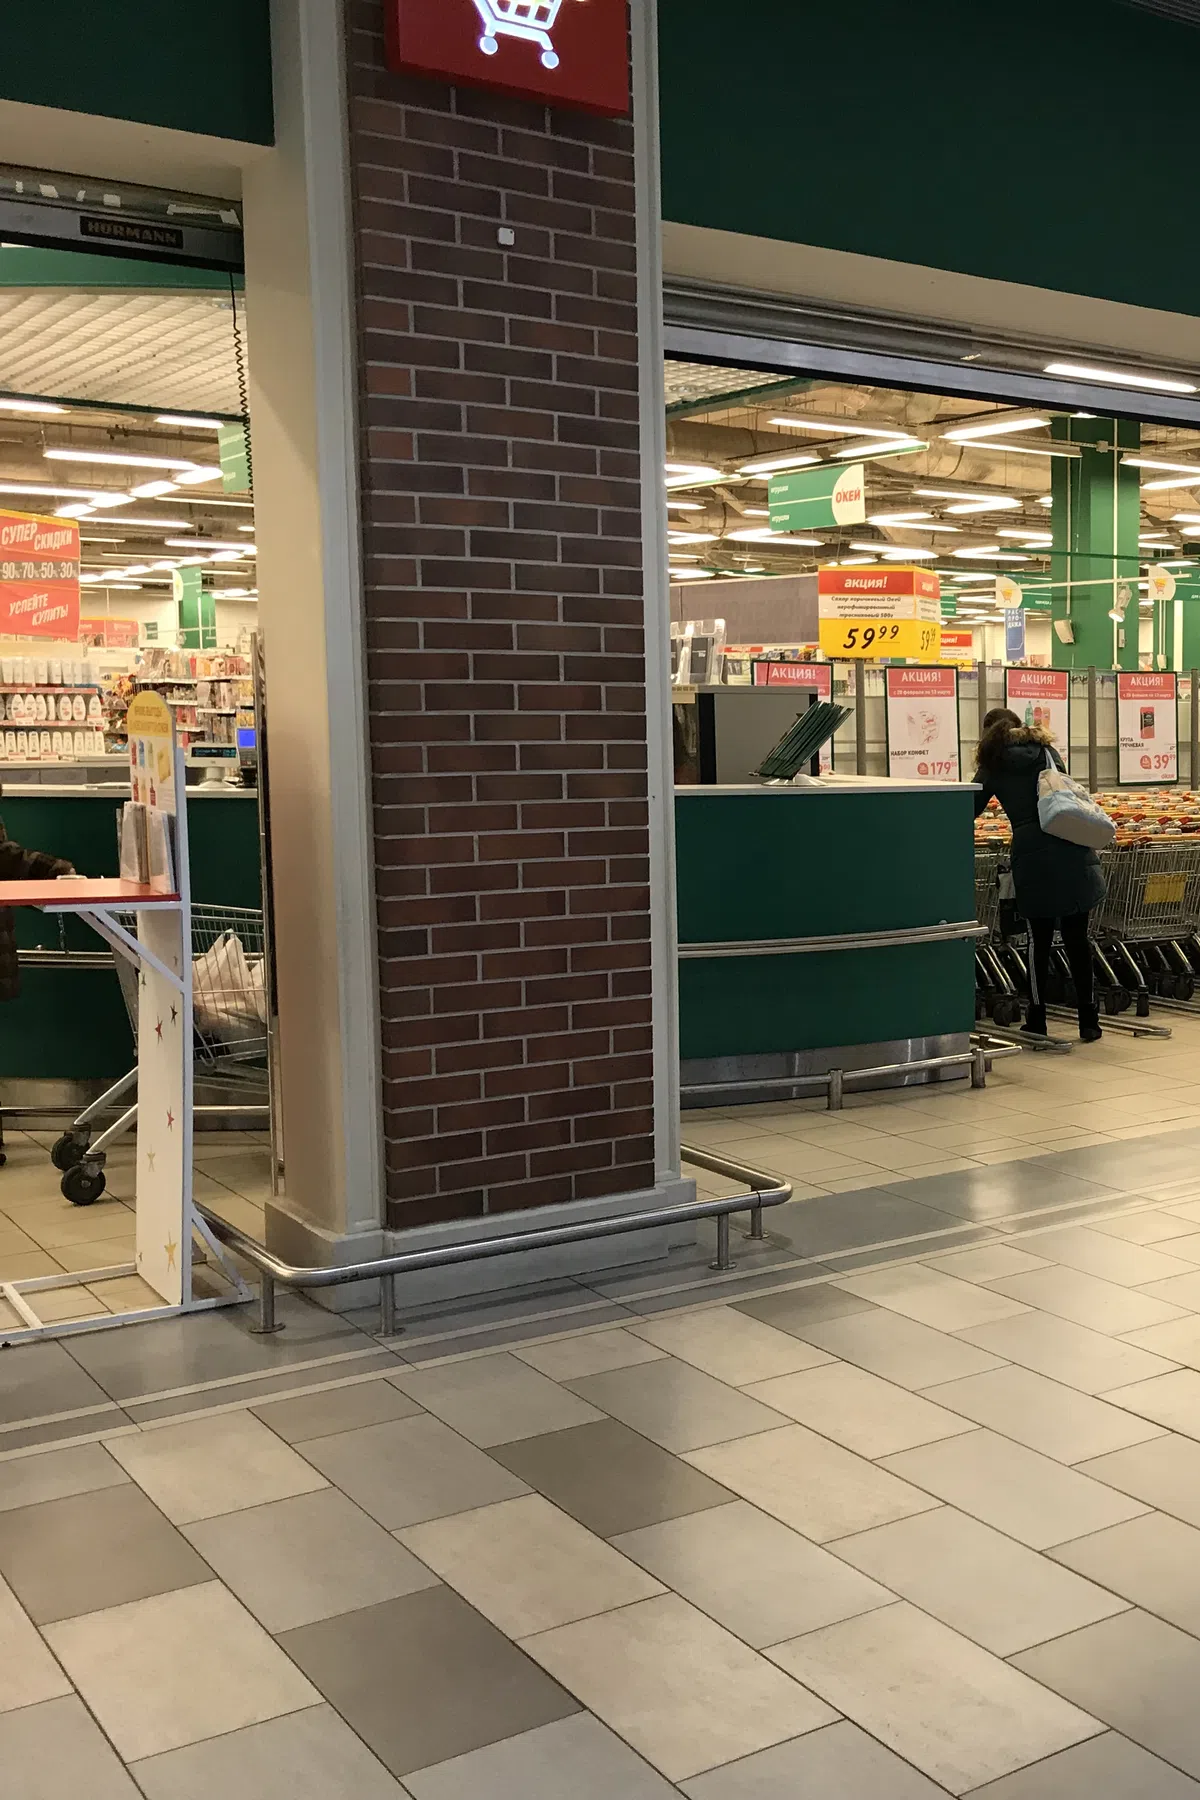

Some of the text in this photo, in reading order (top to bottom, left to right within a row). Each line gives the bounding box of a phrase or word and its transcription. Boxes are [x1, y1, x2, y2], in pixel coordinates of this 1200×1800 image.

[2, 523, 38, 545] СУПЕР
[34, 529, 73, 551] СКИДКИ
[844, 576, 888, 589] акция!
[9, 593, 49, 616] УСПЕЙТЕ
[771, 667, 816, 680] АКЦИЯ!
[901, 671, 942, 683] АКЦИЯ!
[1020, 674, 1056, 685] АКЦИЯ!
[1130, 676, 1164, 686] АКЦИЯ!
